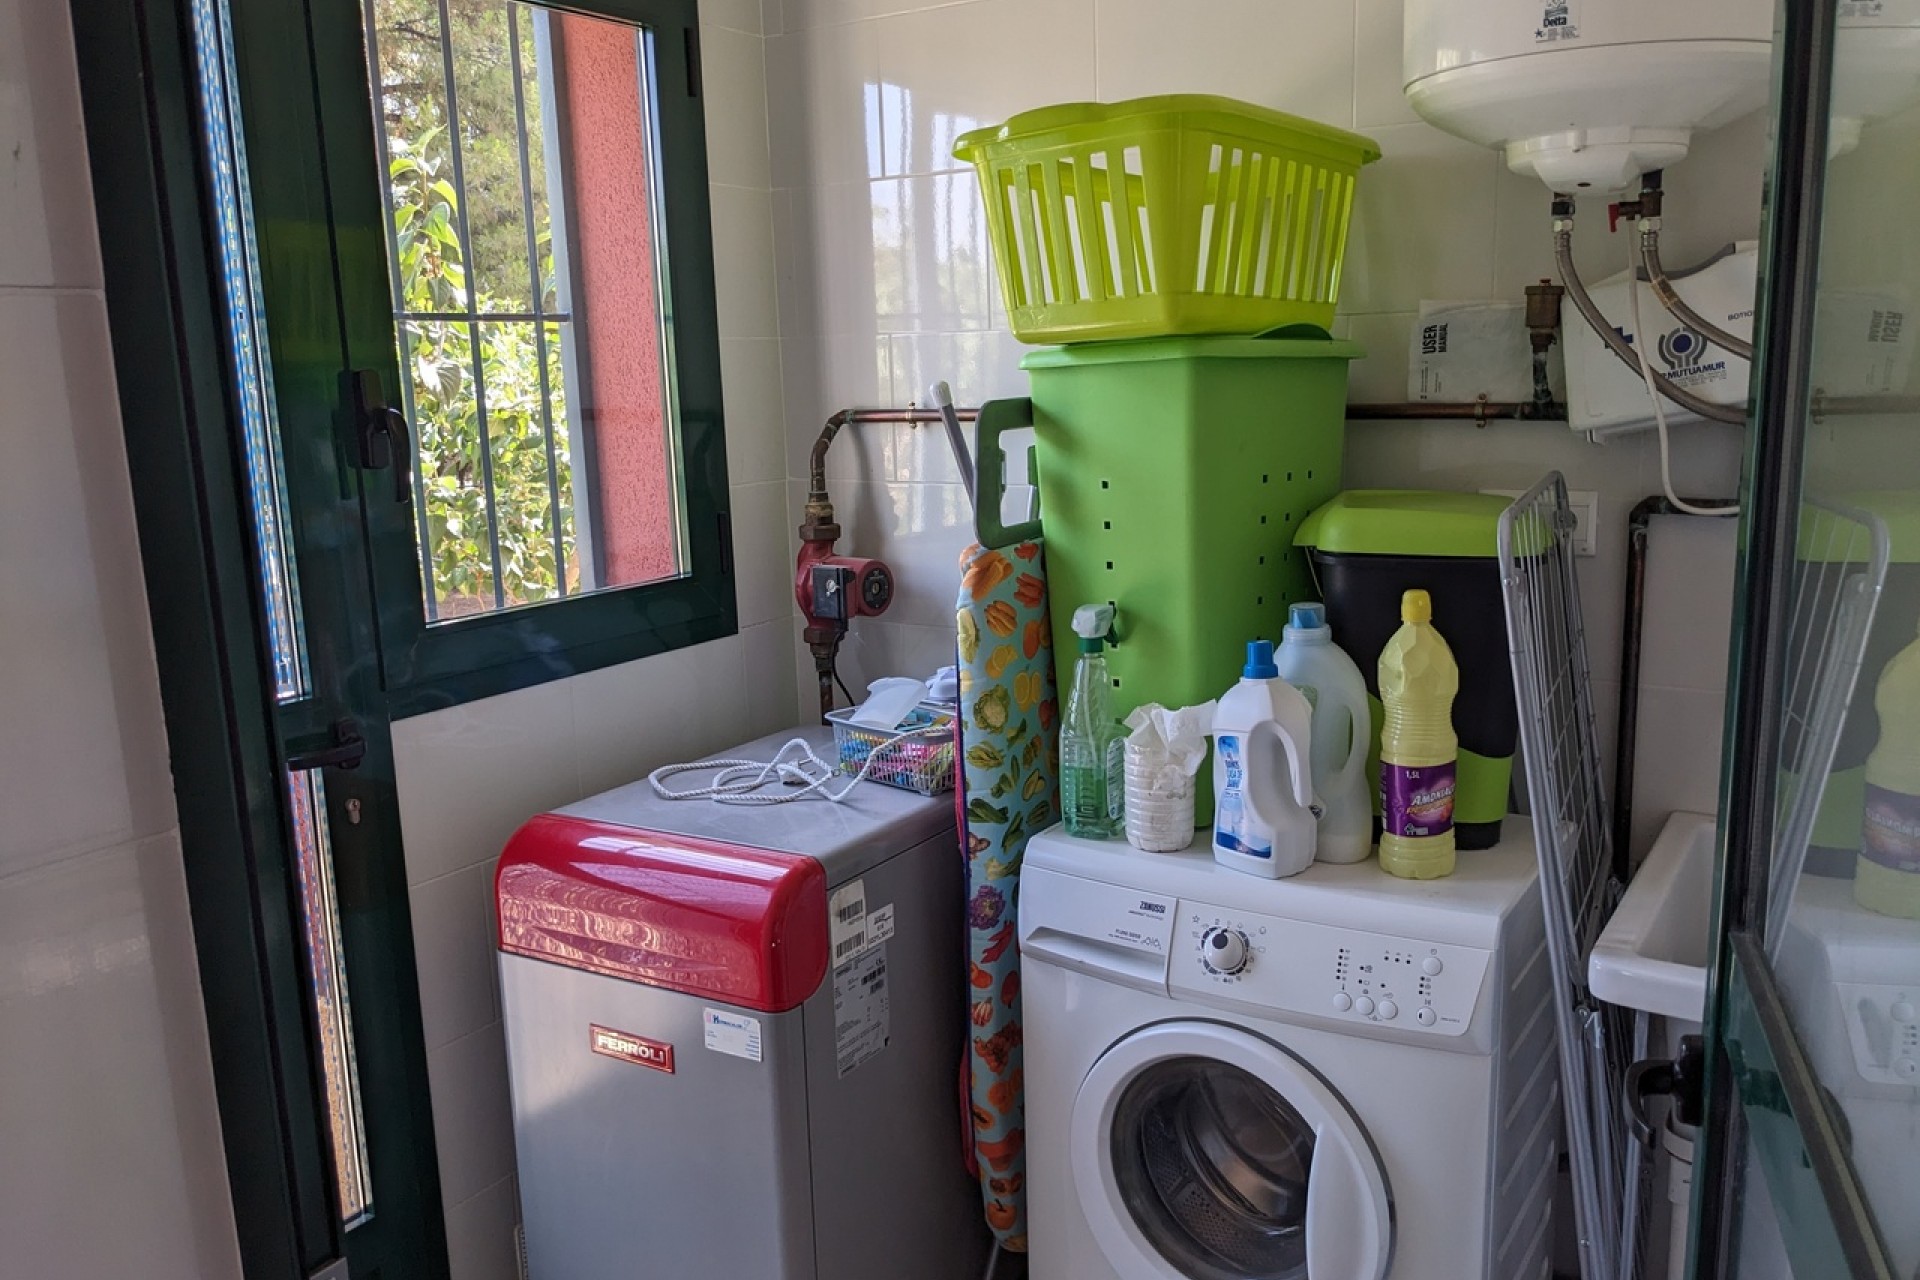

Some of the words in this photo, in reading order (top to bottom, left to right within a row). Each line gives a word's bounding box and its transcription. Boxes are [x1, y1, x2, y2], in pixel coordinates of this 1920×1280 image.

[1543, 16, 1567, 28] Delta
[1422, 324, 1438, 354] USER
[1139, 900, 1166, 914] ZANUSSI
[597, 1033, 665, 1064] FERROLI
